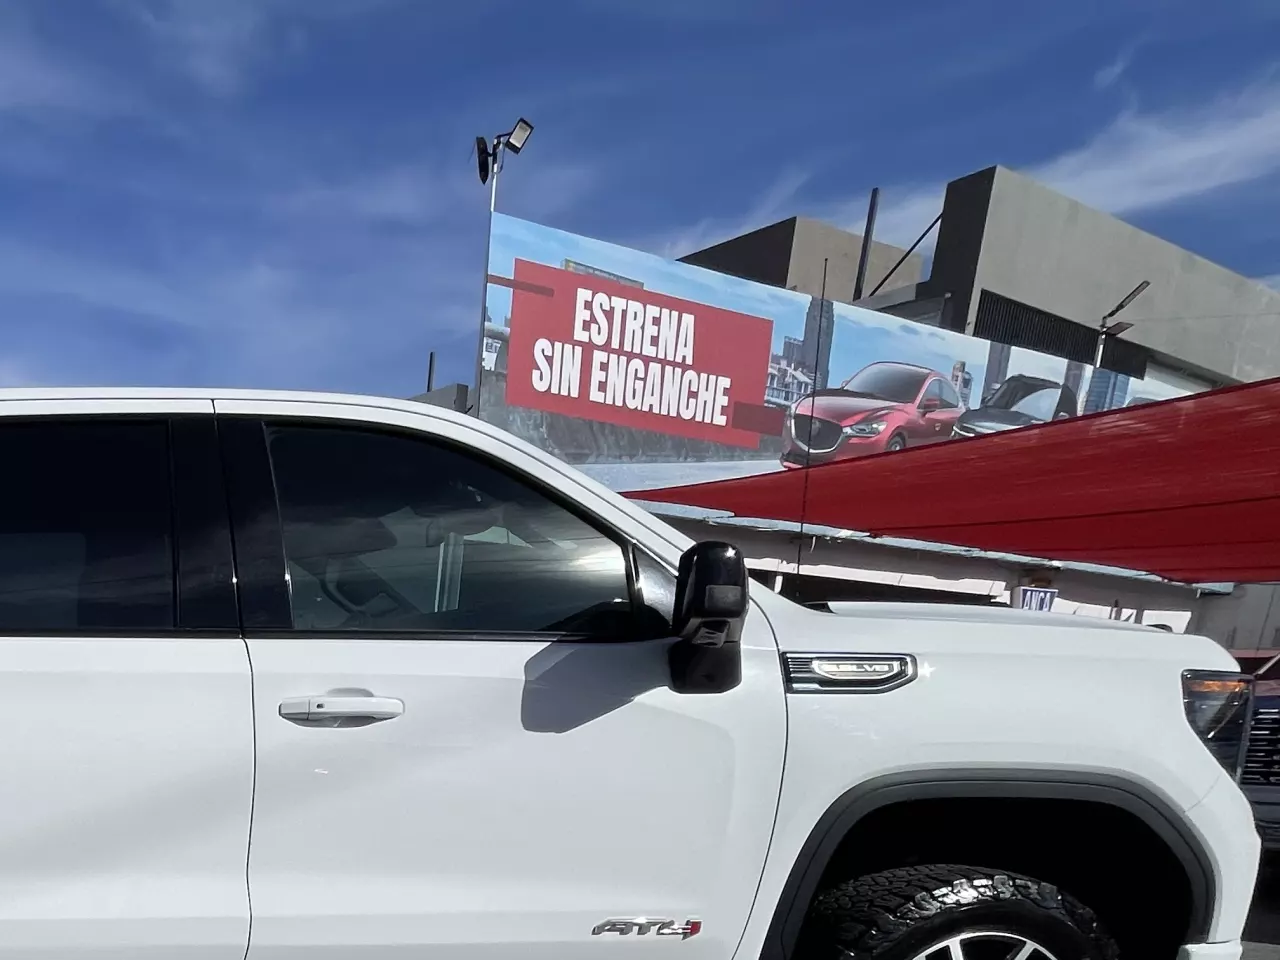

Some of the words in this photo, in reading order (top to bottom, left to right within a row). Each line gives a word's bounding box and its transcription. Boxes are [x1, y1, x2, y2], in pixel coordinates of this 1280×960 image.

[573, 288, 695, 365] ESTRENA
[531, 338, 583, 398] SIN
[589, 349, 732, 427] ENGANCHE
[1022, 590, 1052, 613] ANCA
[591, 915, 703, 941] AT4
